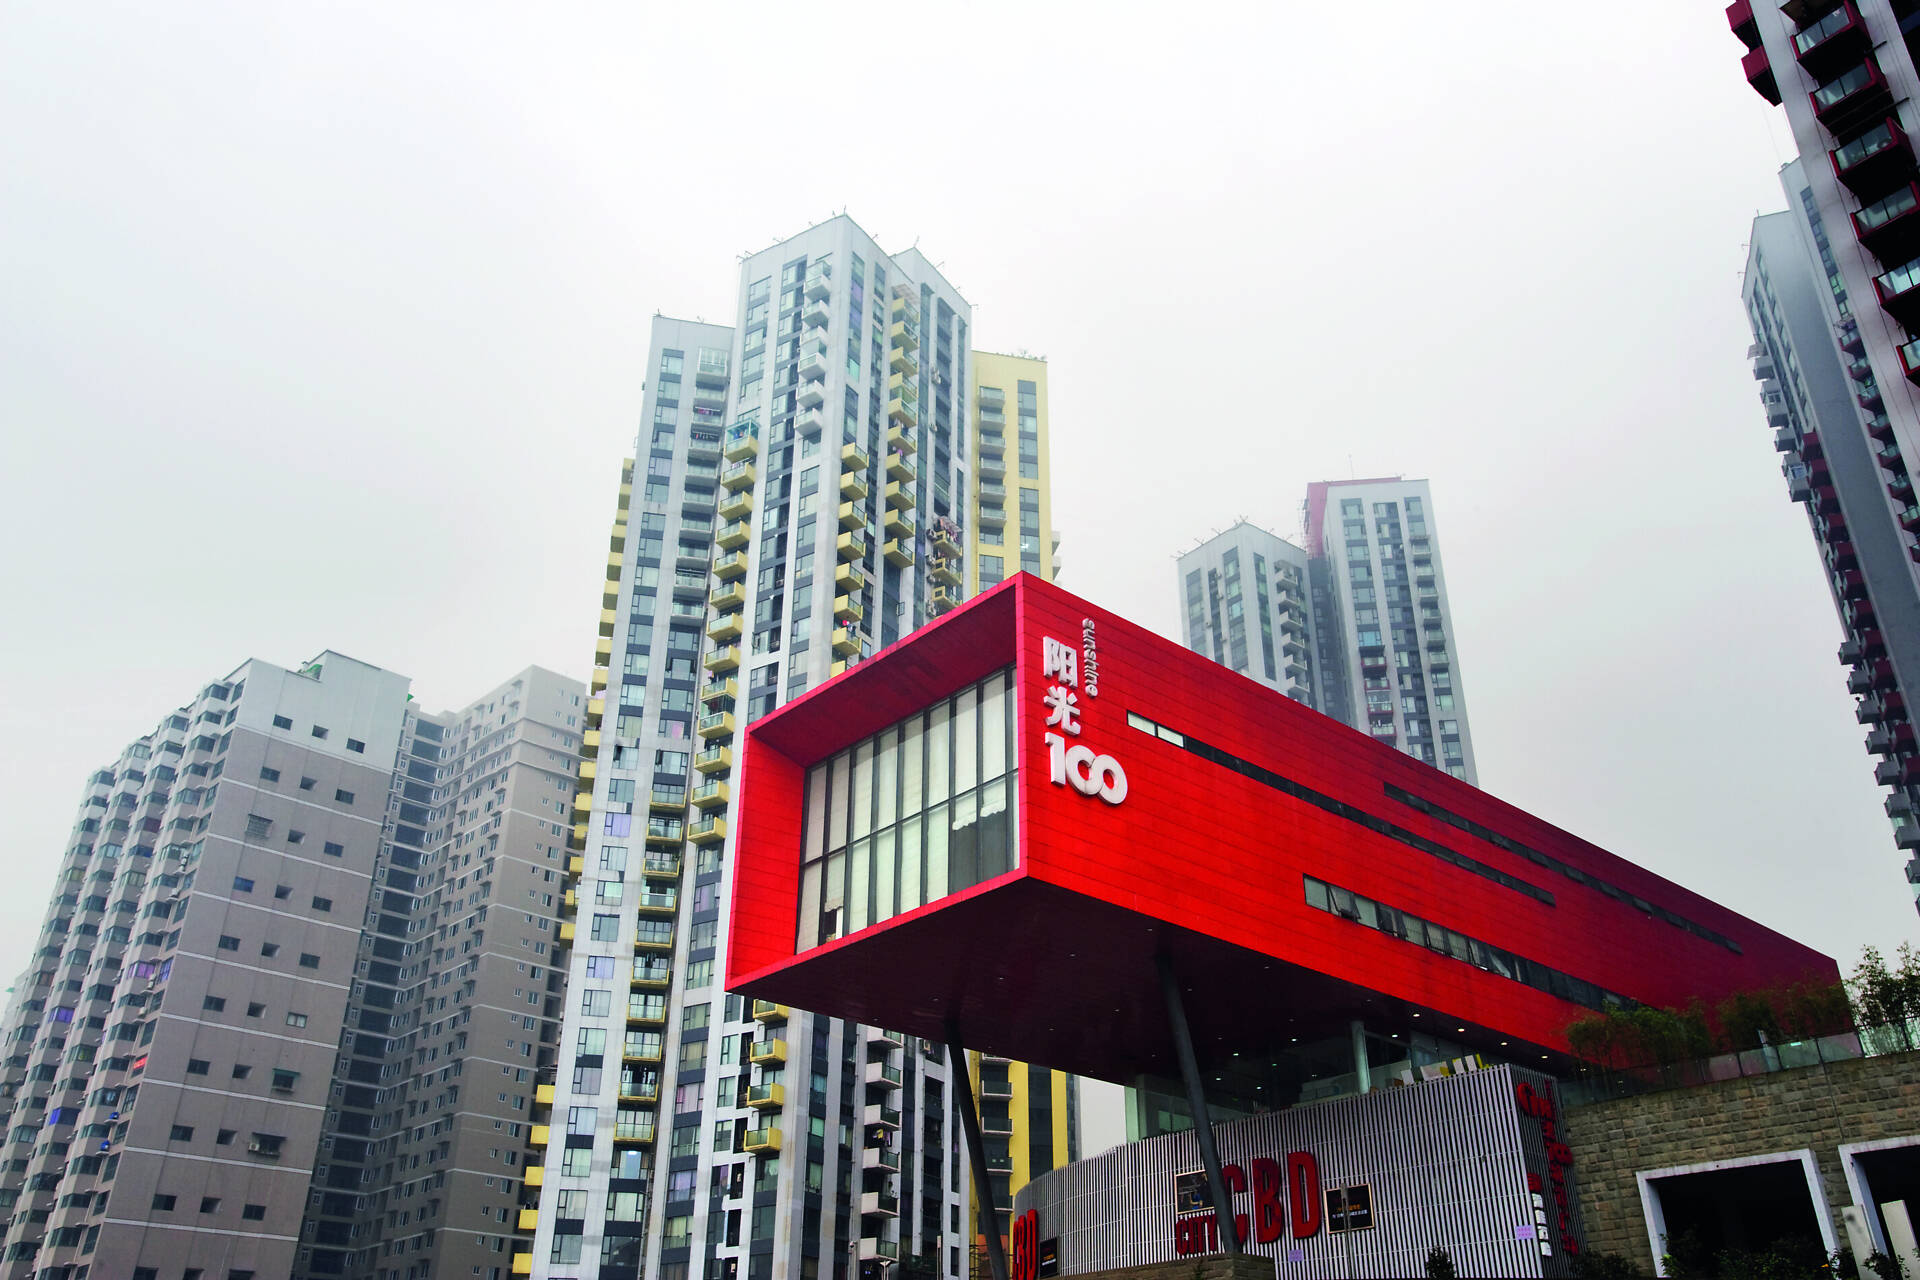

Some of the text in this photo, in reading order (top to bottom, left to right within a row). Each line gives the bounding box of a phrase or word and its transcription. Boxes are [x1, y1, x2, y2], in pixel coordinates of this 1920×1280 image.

[1043, 635, 1081, 735] 阳光
[1082, 617, 1099, 698] sunshine
[1045, 731, 1128, 805] 100
[1175, 1212, 1217, 1255] CITY
